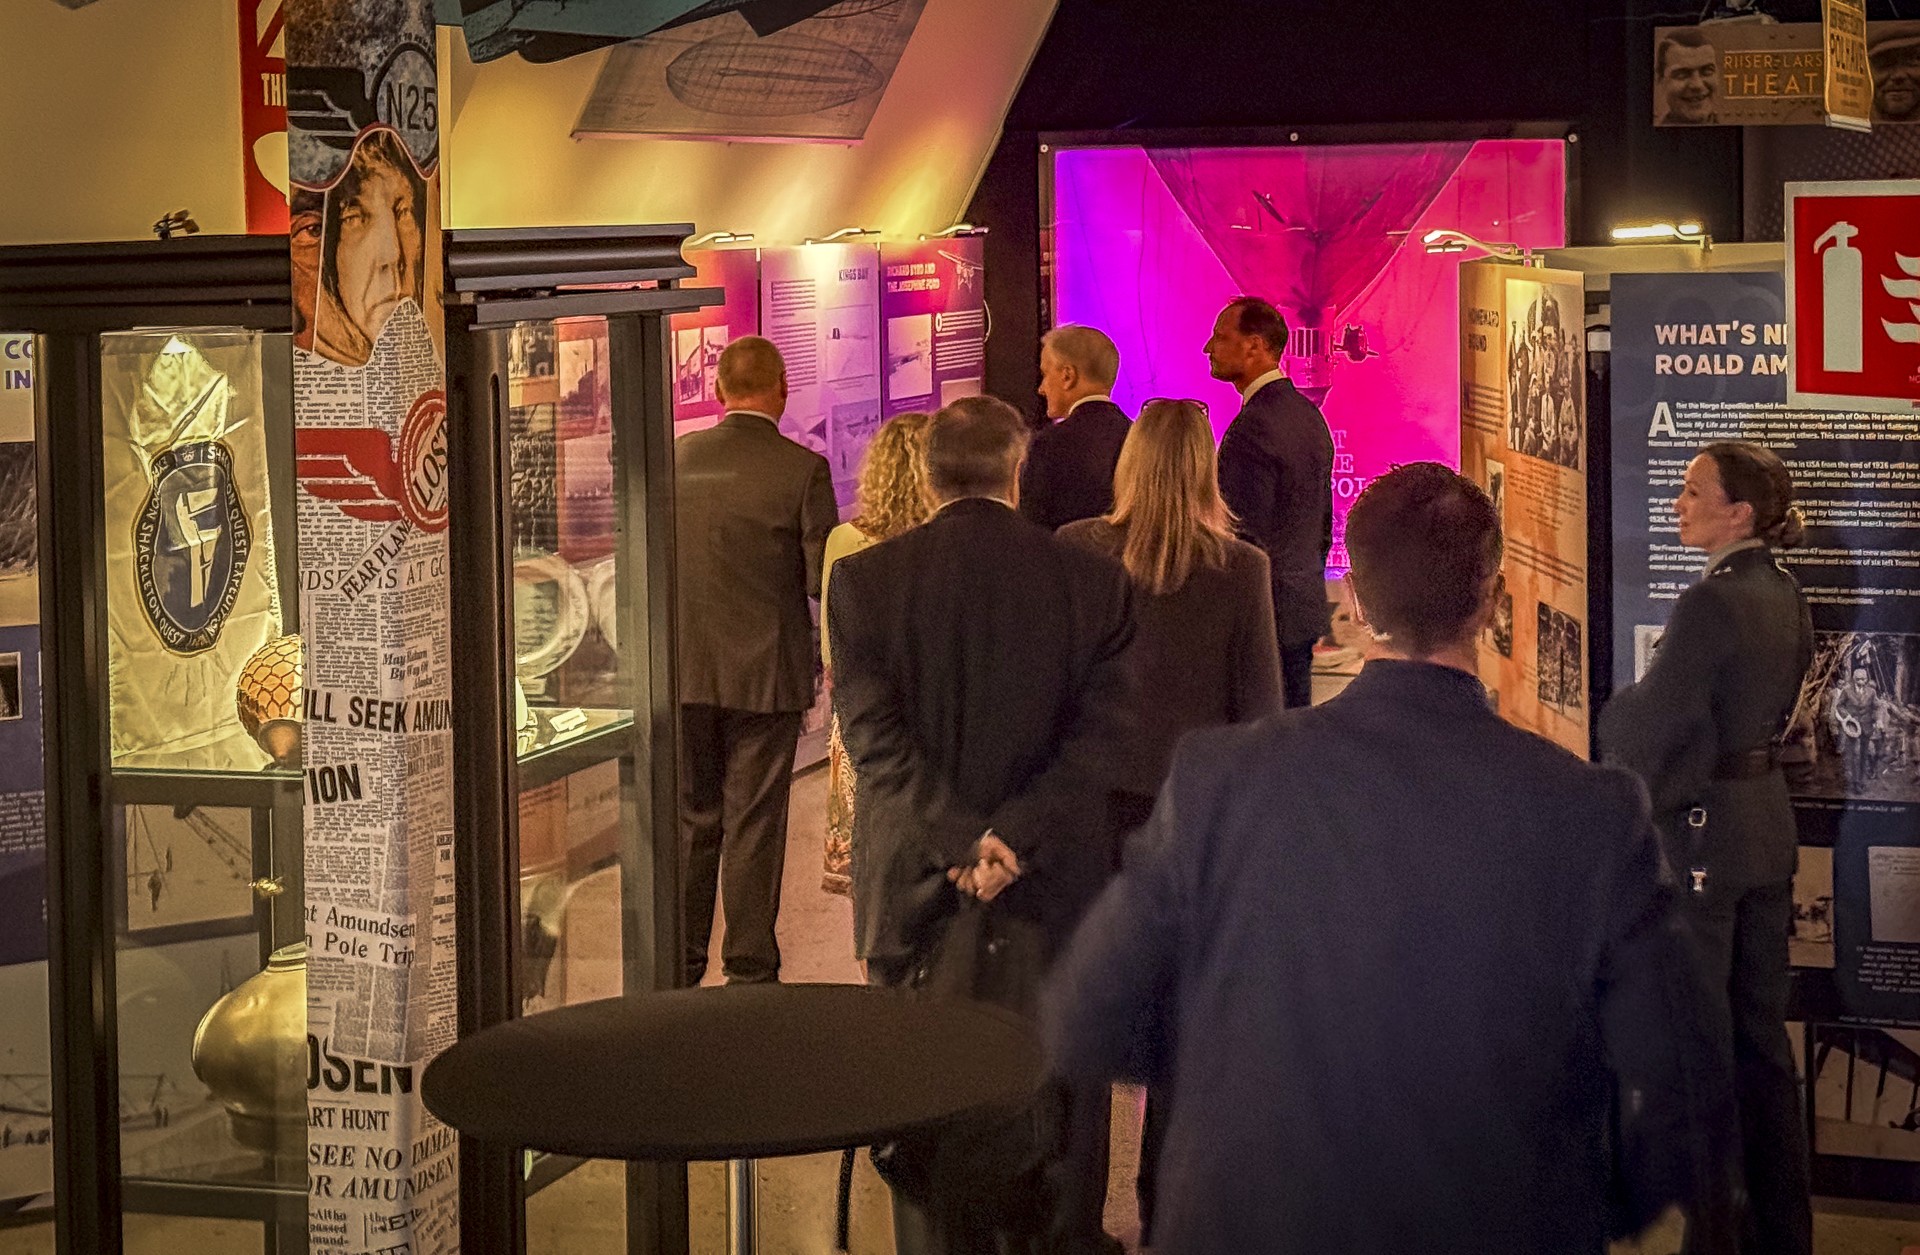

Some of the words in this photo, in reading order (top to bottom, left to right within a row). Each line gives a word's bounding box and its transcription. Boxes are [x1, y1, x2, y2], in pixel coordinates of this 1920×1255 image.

[1724, 73, 1818, 95] THEAT
[386, 82, 437, 131] N25
[1655, 320, 1756, 346] WHAT'S
[1655, 354, 1744, 376] ROALD
[5, 369, 31, 390] IN
[1694, 422, 1704, 430] My
[1705, 421, 1718, 429] Life
[1799, 422, 1833, 430] described
[1821, 432, 1835, 440] This
[1891, 471, 1906, 481] July
[230, 507, 248, 556] QUEST
[138, 520, 162, 620] SHACKLETON
[340, 559, 381, 603] FEAR
[406, 560, 426, 586] AT
[159, 617, 186, 645] QUEST
[382, 652, 406, 667] May
[390, 666, 406, 681] By
[301, 687, 337, 723] ILL
[348, 695, 407, 734] SEEK
[325, 905, 416, 938] Amundsen
[324, 932, 368, 959] Pole
[379, 942, 415, 968] Trip
[341, 1108, 390, 1132] HUNT
[308, 1143, 355, 1168] SEE
[364, 1146, 403, 1172] NO
[340, 1152, 456, 1202] AMUNDSEN
